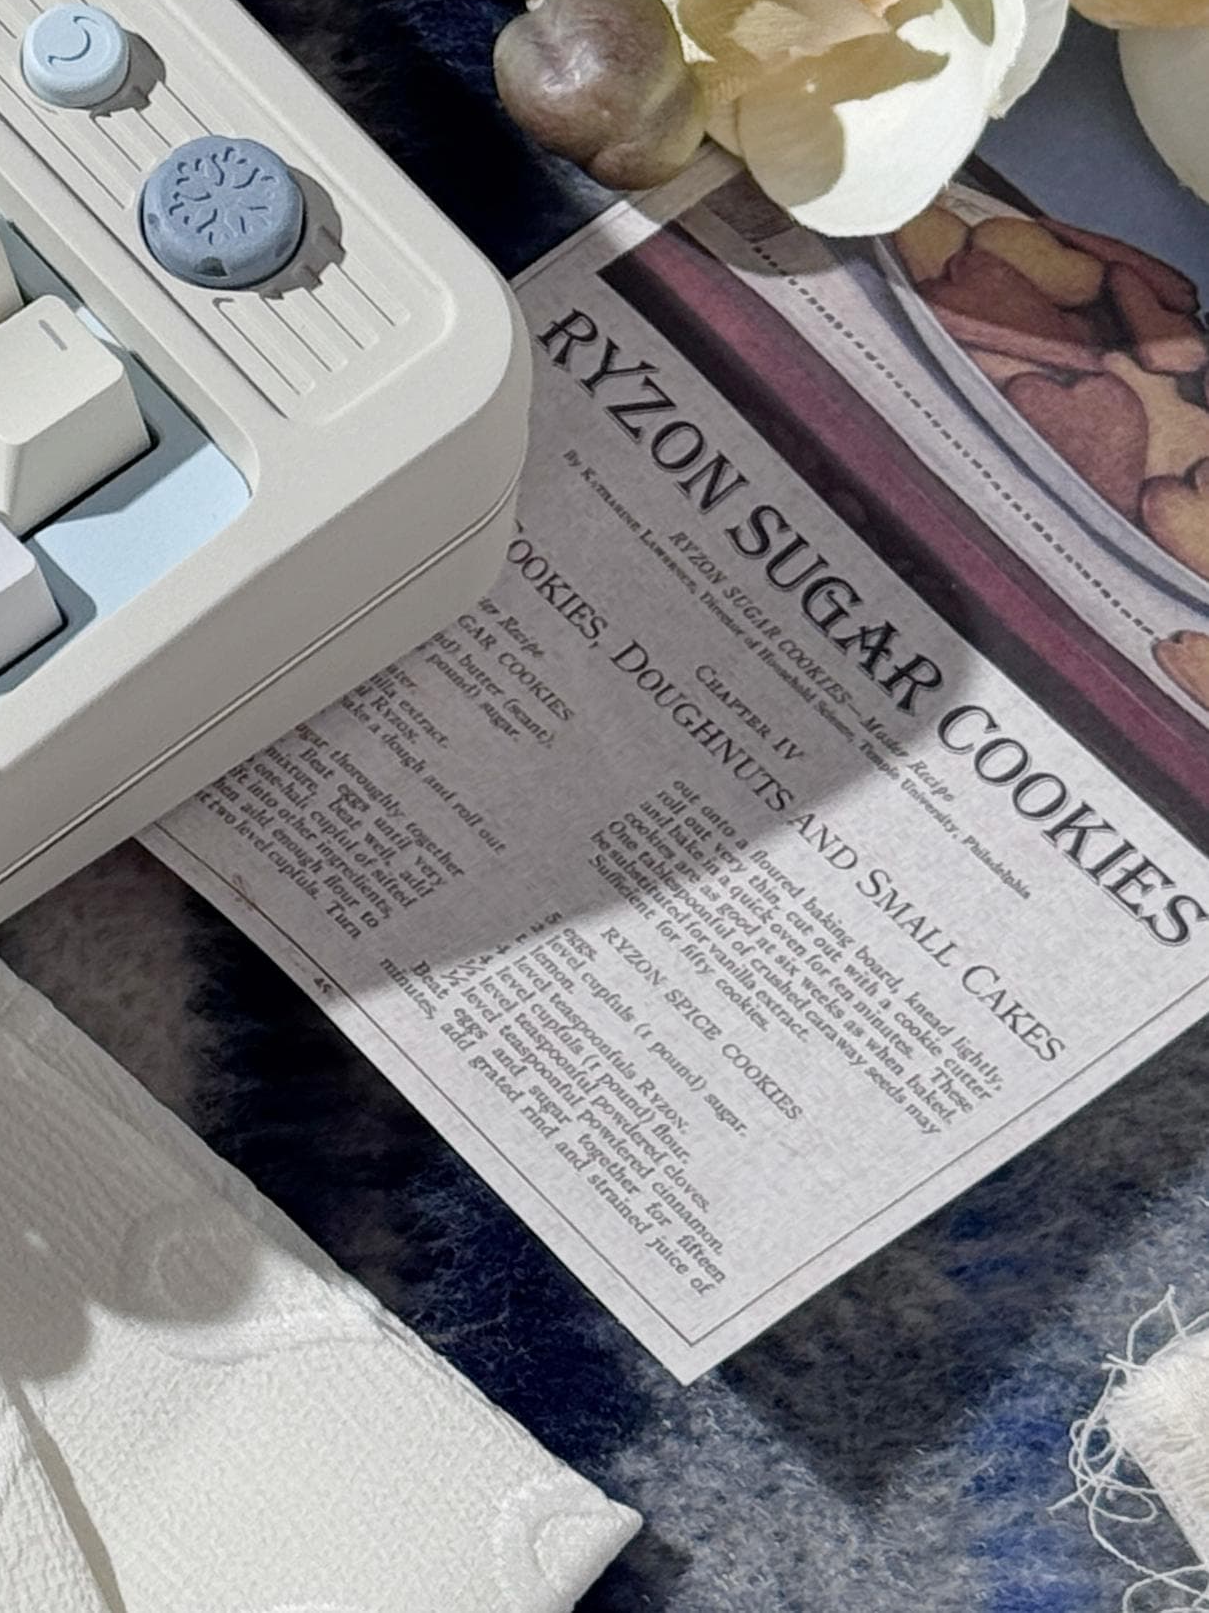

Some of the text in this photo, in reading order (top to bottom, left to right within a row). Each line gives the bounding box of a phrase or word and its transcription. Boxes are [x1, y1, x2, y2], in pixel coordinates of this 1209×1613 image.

[498, 652, 572, 720] COOKIES
[536, 307, 1205, 947] RYZON SUGAR COOKIES
[669, 532, 726, 583] RYZON
[723, 587, 780, 638] SUGAR
[907, 761, 954, 801] Recipe
[330, 751, 463, 875] thoroughly together
[382, 734, 425, 772] dough
[508, 522, 1063, 1060] OOKIES, DOUGHNUTS AND SMALL CAKES
[772, 737, 803, 759] IV
[901, 778, 958, 838] University,
[962, 836, 1029, 898] Philadelphia
[529, 945, 573, 993] lemon.
[589, 854, 768, 1030] Sufficient for fifty cookies.
[608, 821, 940, 1133] One tablespoonful of crushed caraway seeds may
[610, 850, 808, 1041] substituted vanilla extract.
[656, 790, 687, 814] roll
[684, 817, 711, 841] out
[714, 842, 746, 872] very
[786, 911, 813, 935] cut
[813, 937, 841, 962] out
[844, 964, 878, 996] with
[894, 1012, 941, 1055] cookie
[944, 1058, 991, 1098] cutter
[673, 780, 1001, 1090] out onto floured baking board, knead lightly,
[550, 993, 635, 1078] teaspoonfuls
[601, 927, 801, 1118] RYZON SPICE COOKIES
[577, 1109, 654, 1178] powdered
[578, 1133, 724, 1283] together fifteen
[588, 1175, 688, 1273] strained juice
